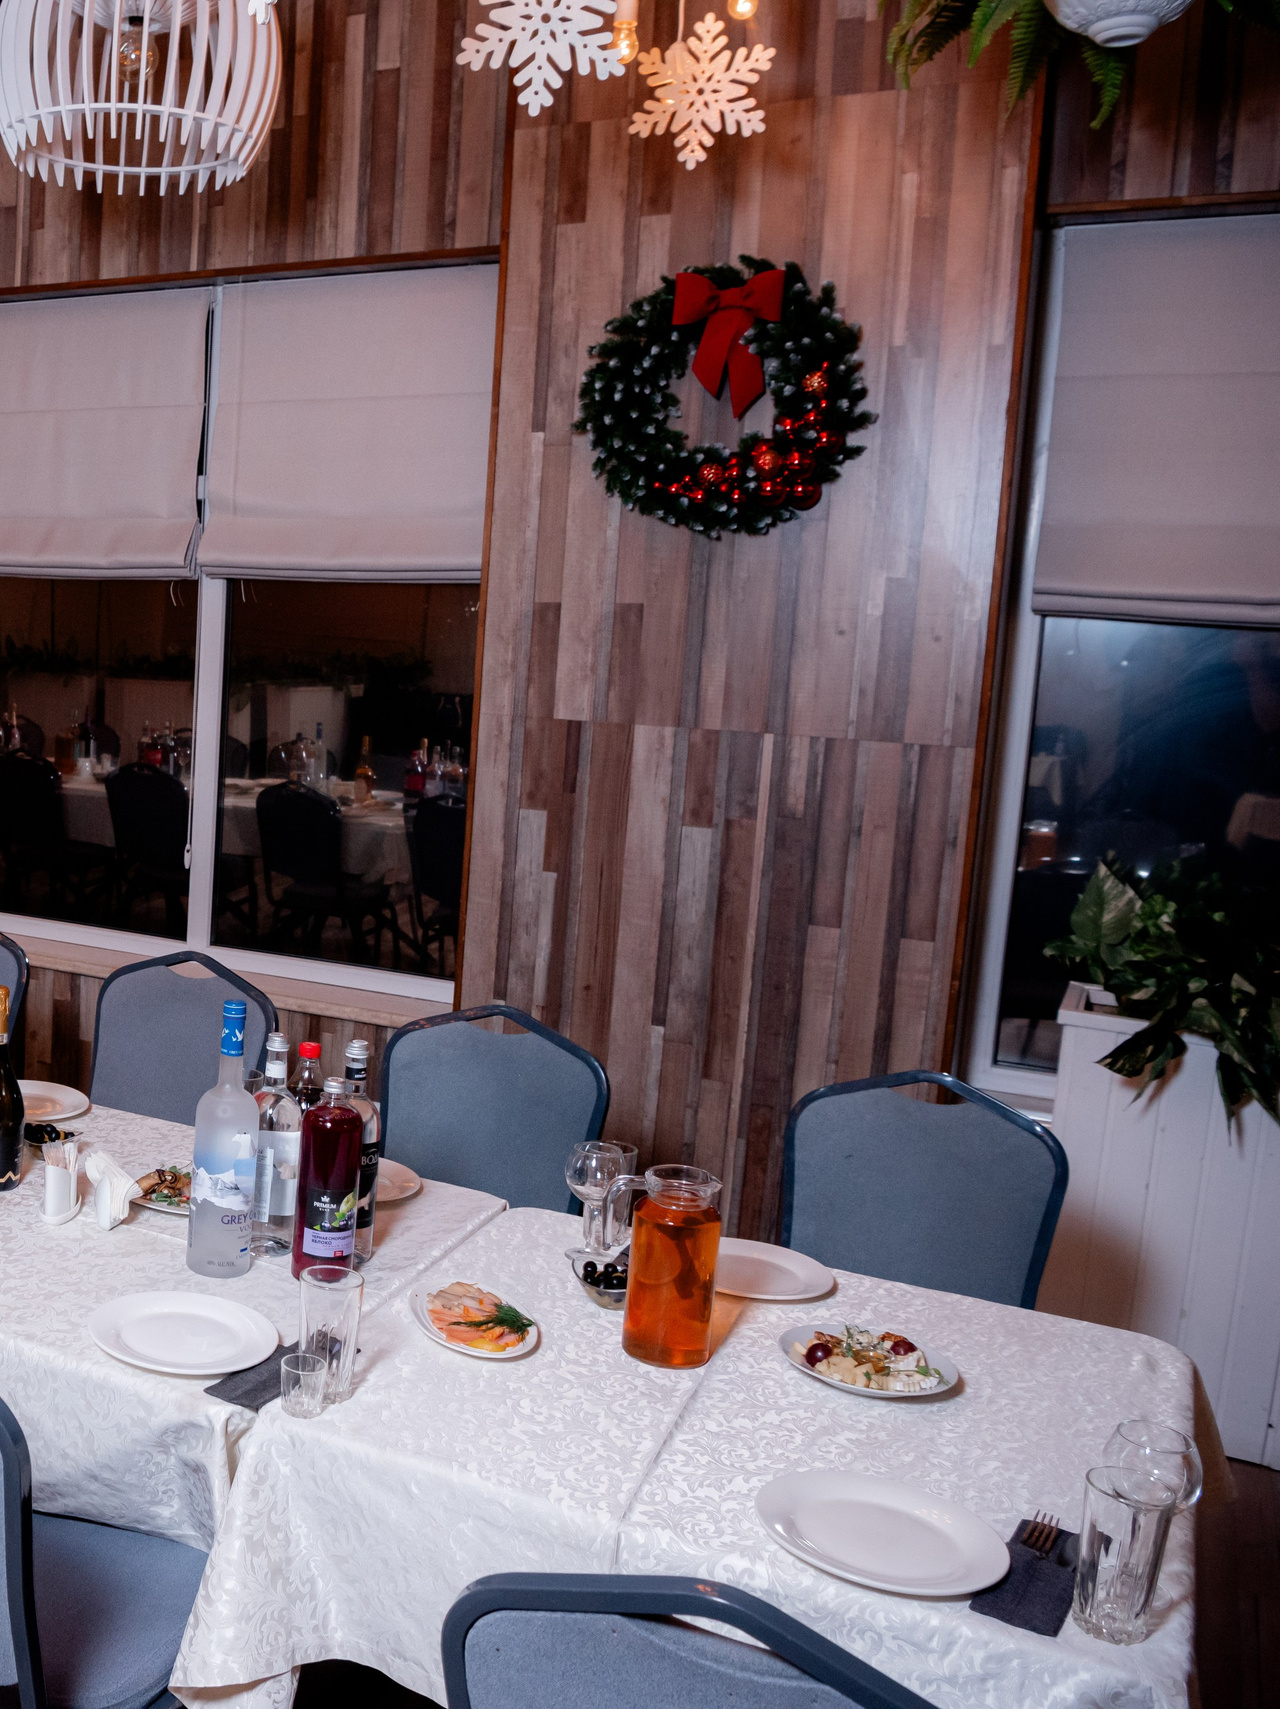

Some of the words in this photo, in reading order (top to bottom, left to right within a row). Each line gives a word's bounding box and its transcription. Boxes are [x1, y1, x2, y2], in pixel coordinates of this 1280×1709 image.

[313, 1201, 337, 1209] PREMIUM
[221, 1212, 248, 1225] GREY
[311, 1238, 333, 1246] ЯБЛОКО
